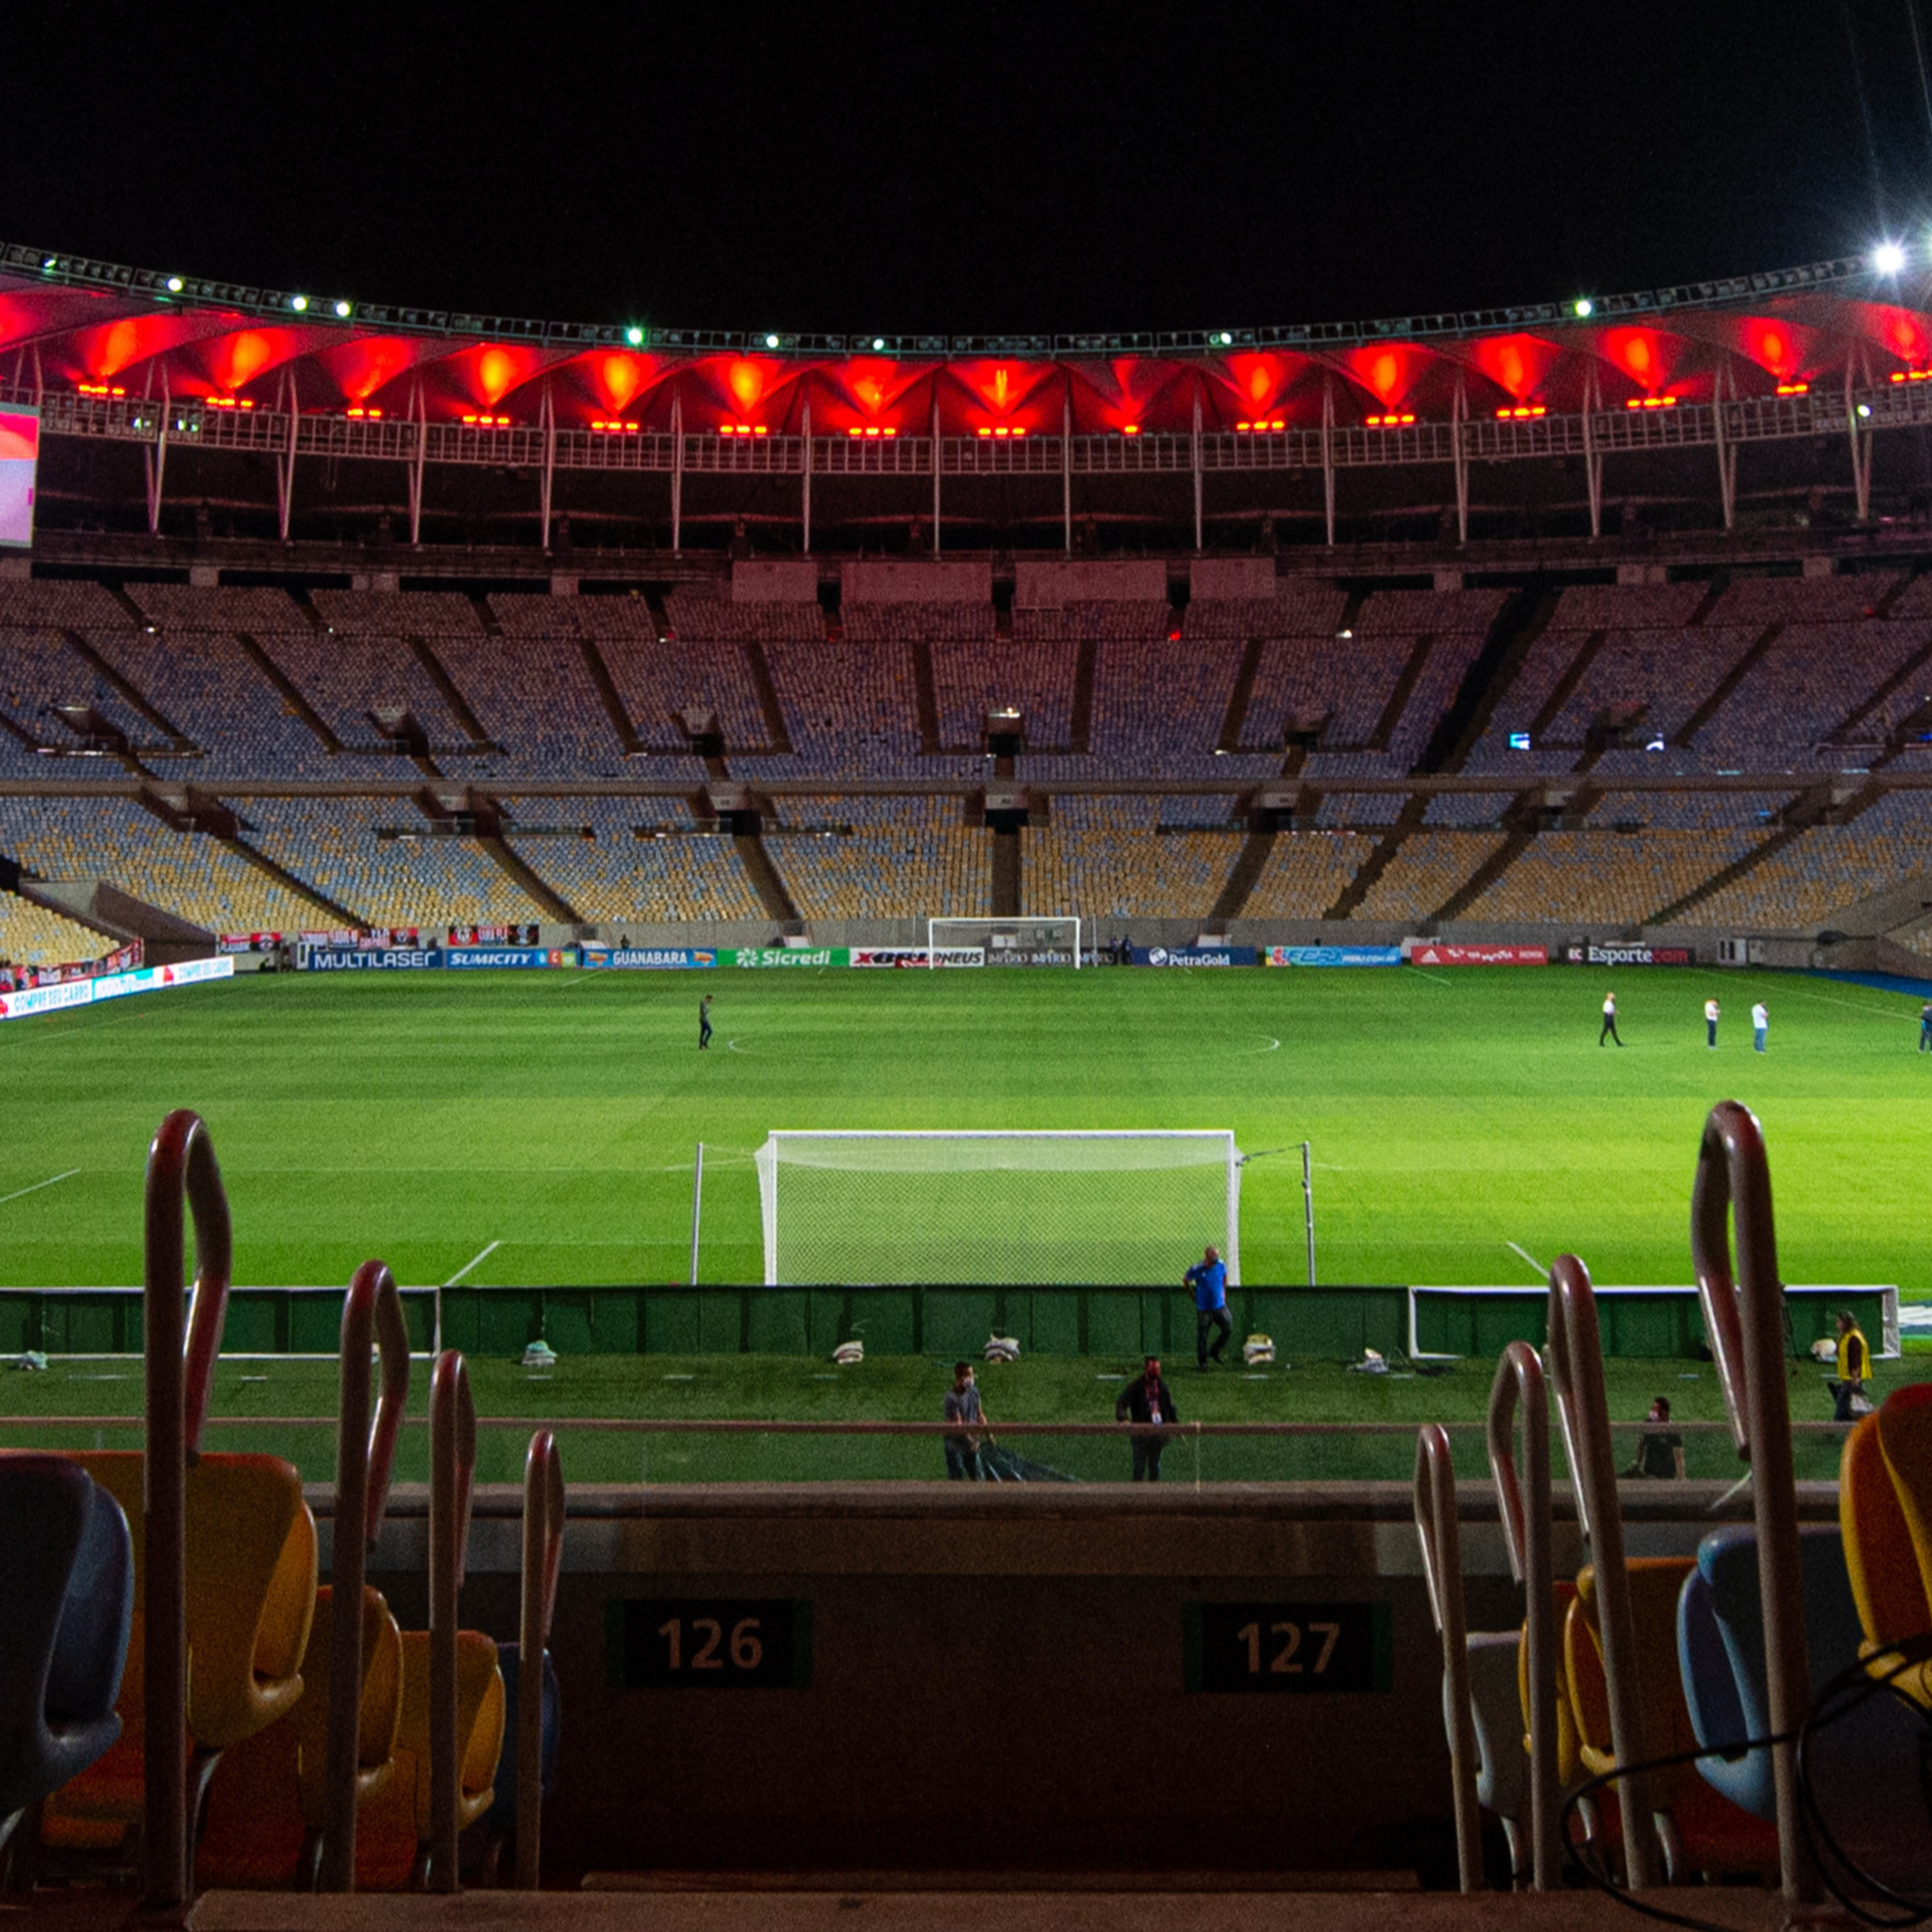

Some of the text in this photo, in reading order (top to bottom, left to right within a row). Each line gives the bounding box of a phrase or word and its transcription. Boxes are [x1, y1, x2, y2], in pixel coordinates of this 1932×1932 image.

[450, 952, 531, 965] SUMICITY
[612, 951, 688, 965] GUANABARA
[761, 950, 831, 965] Sicredi
[1169, 953, 1231, 966] PetraGold
[14, 984, 89, 1012] COMPRE SEU CARRO
[658, 1617, 762, 1669] 126
[1236, 1622, 1341, 1673] 127
